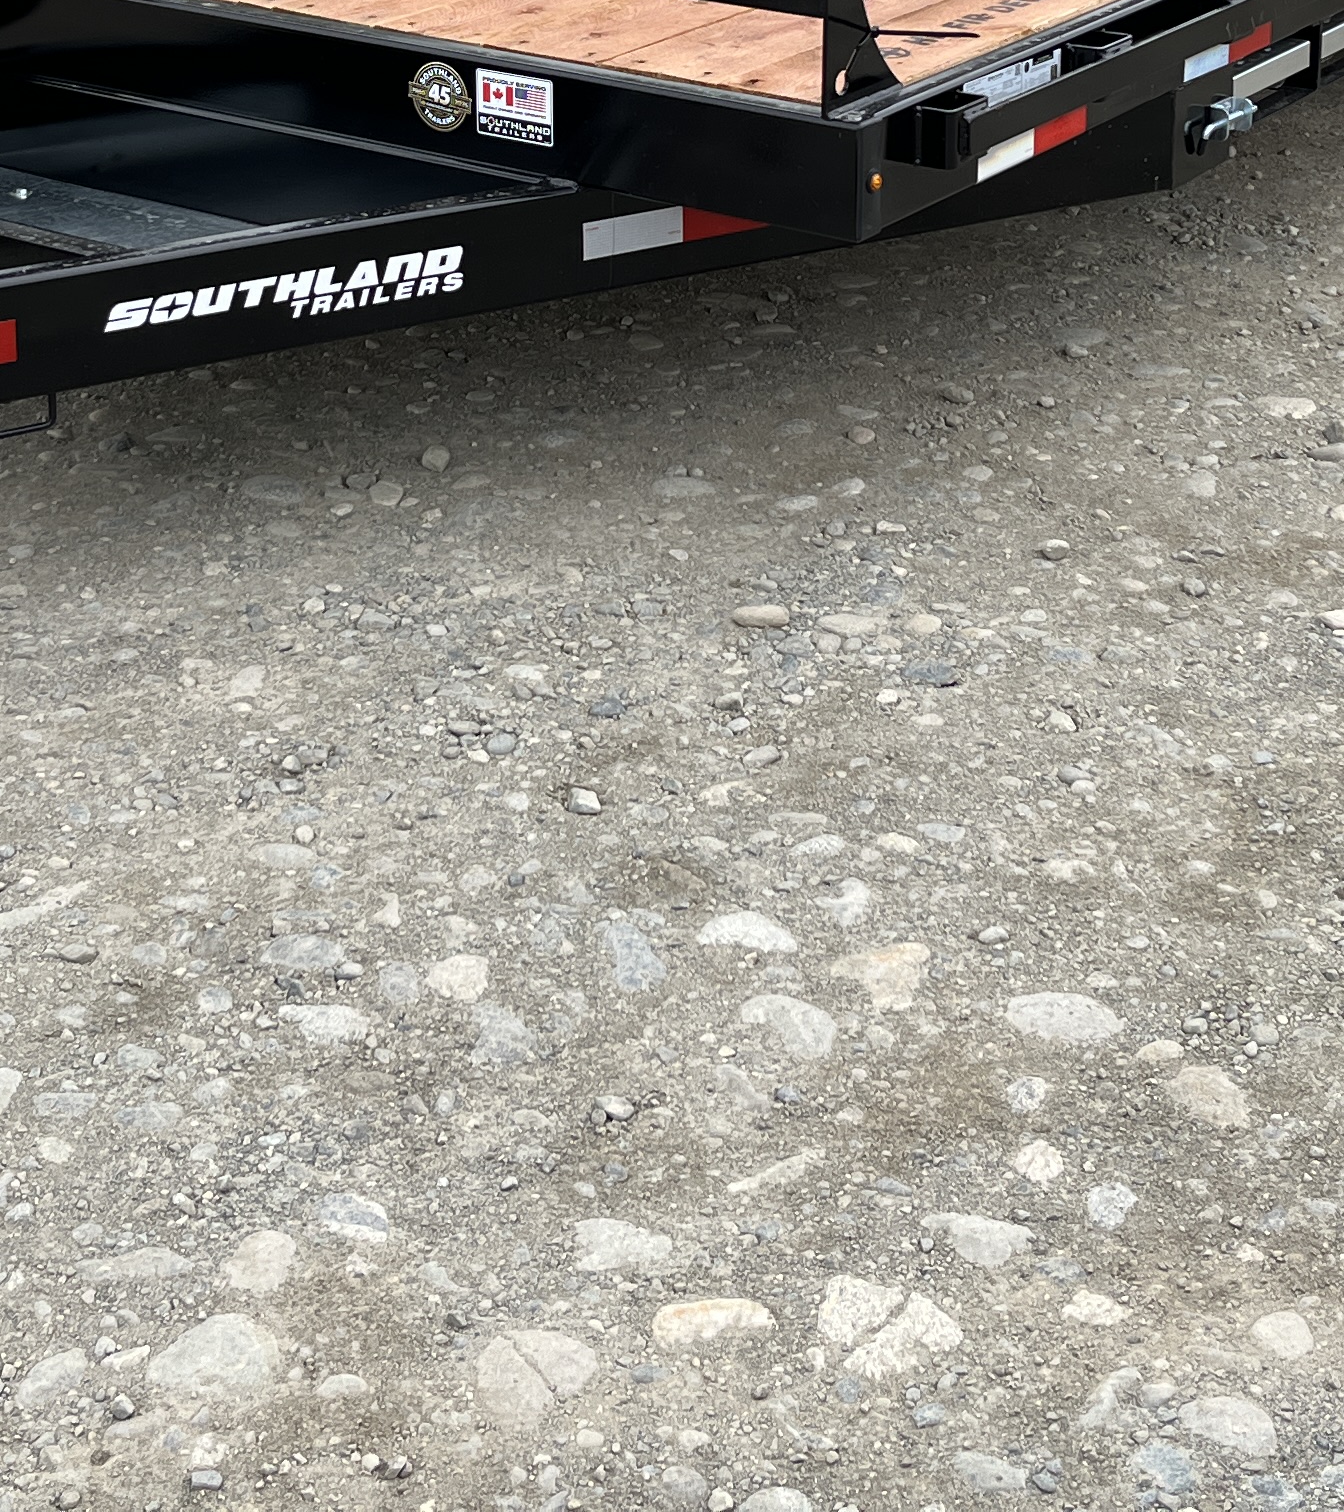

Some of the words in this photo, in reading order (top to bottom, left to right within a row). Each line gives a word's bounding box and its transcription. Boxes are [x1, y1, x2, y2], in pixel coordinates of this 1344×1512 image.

[419, 67, 462, 95] SOUTHLAND
[428, 83, 451, 106] 45
[479, 115, 551, 136] SOUTHLAND
[487, 125, 543, 141] TRAILERS
[104, 245, 464, 334] SOUTHLAND
[289, 272, 464, 320] TRAILERS
